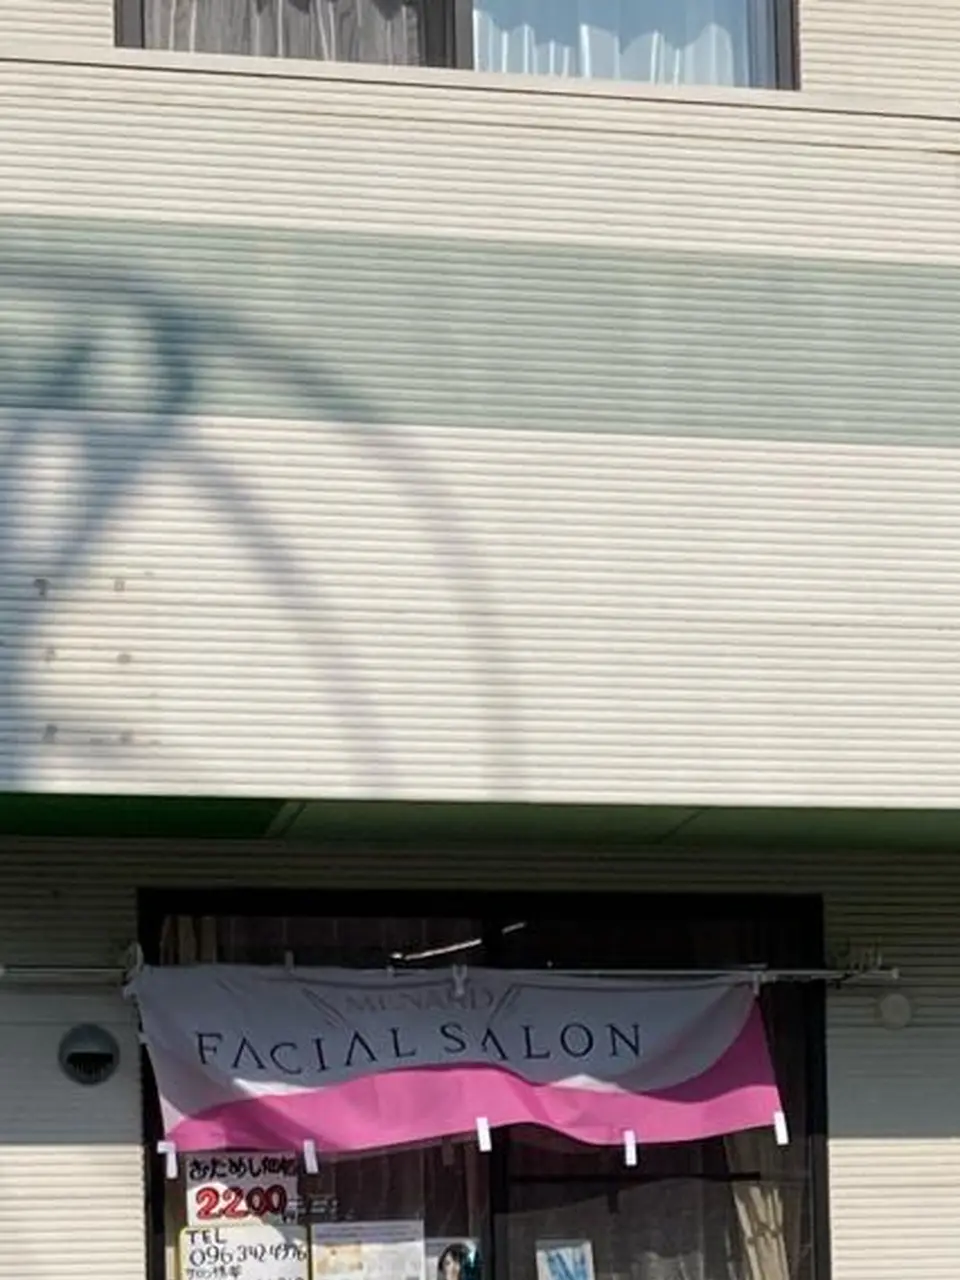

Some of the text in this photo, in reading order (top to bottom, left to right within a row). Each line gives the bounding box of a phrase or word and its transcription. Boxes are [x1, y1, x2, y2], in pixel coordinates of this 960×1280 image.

[196, 1021, 642, 1076] FACIAL SALON
[186, 1228, 228, 1245] TEL
